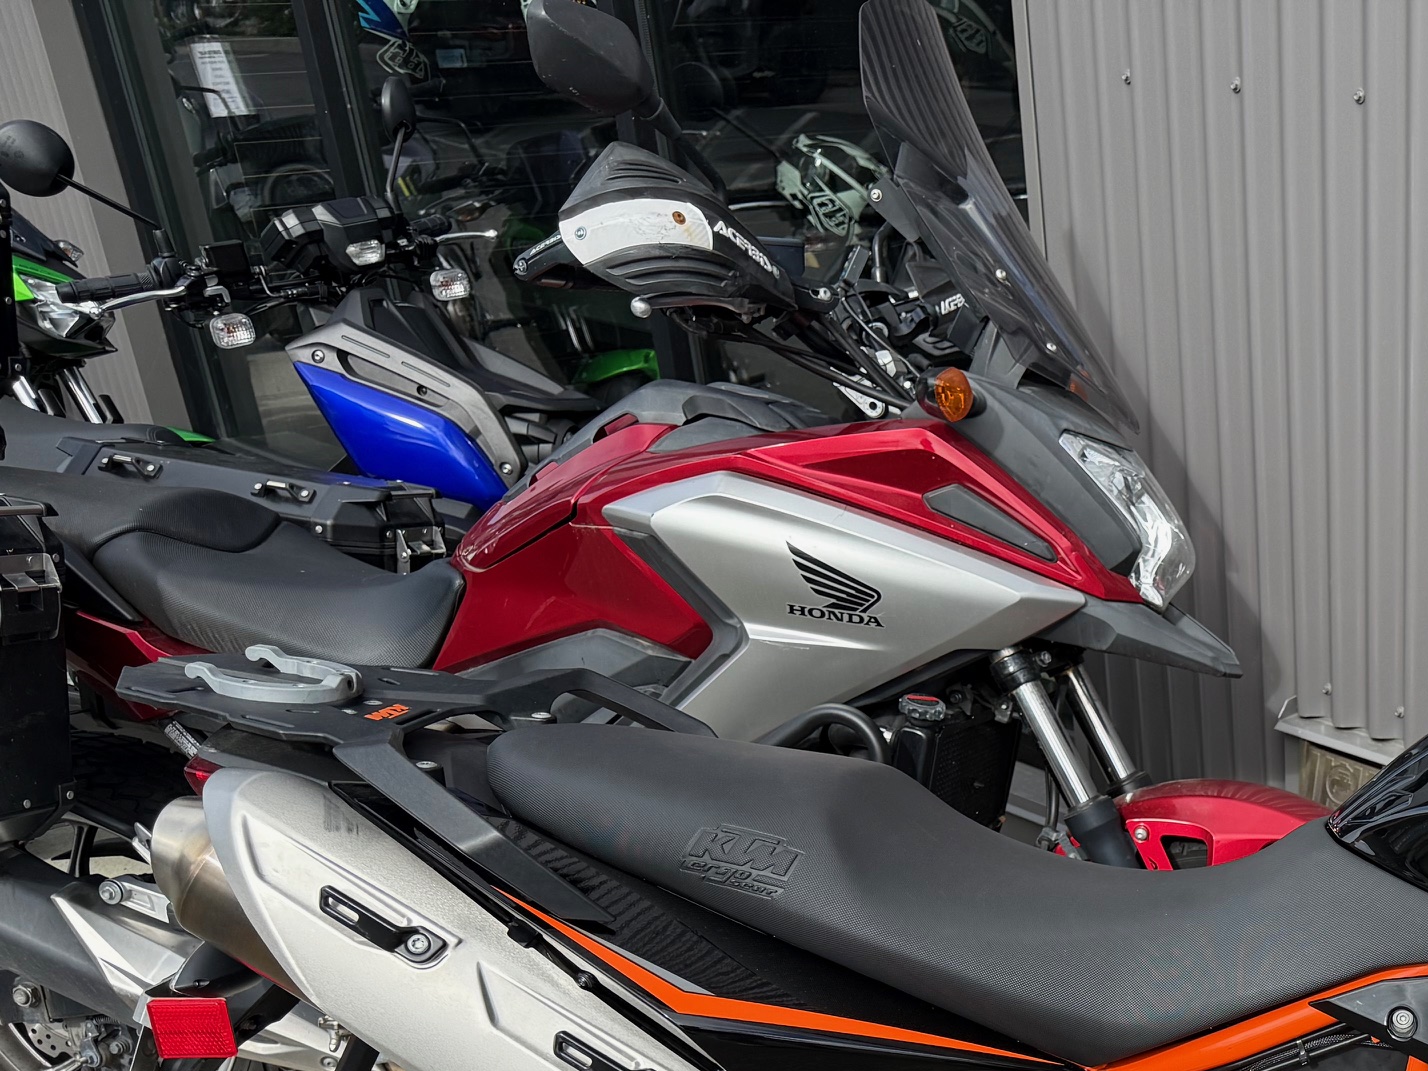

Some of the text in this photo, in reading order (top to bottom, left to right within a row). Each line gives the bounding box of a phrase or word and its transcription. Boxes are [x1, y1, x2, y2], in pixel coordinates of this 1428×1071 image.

[713, 221, 772, 272] ACERBIS
[787, 604, 885, 628] HONDA
[688, 829, 799, 878] KTM
[690, 861, 752, 884] ergo
